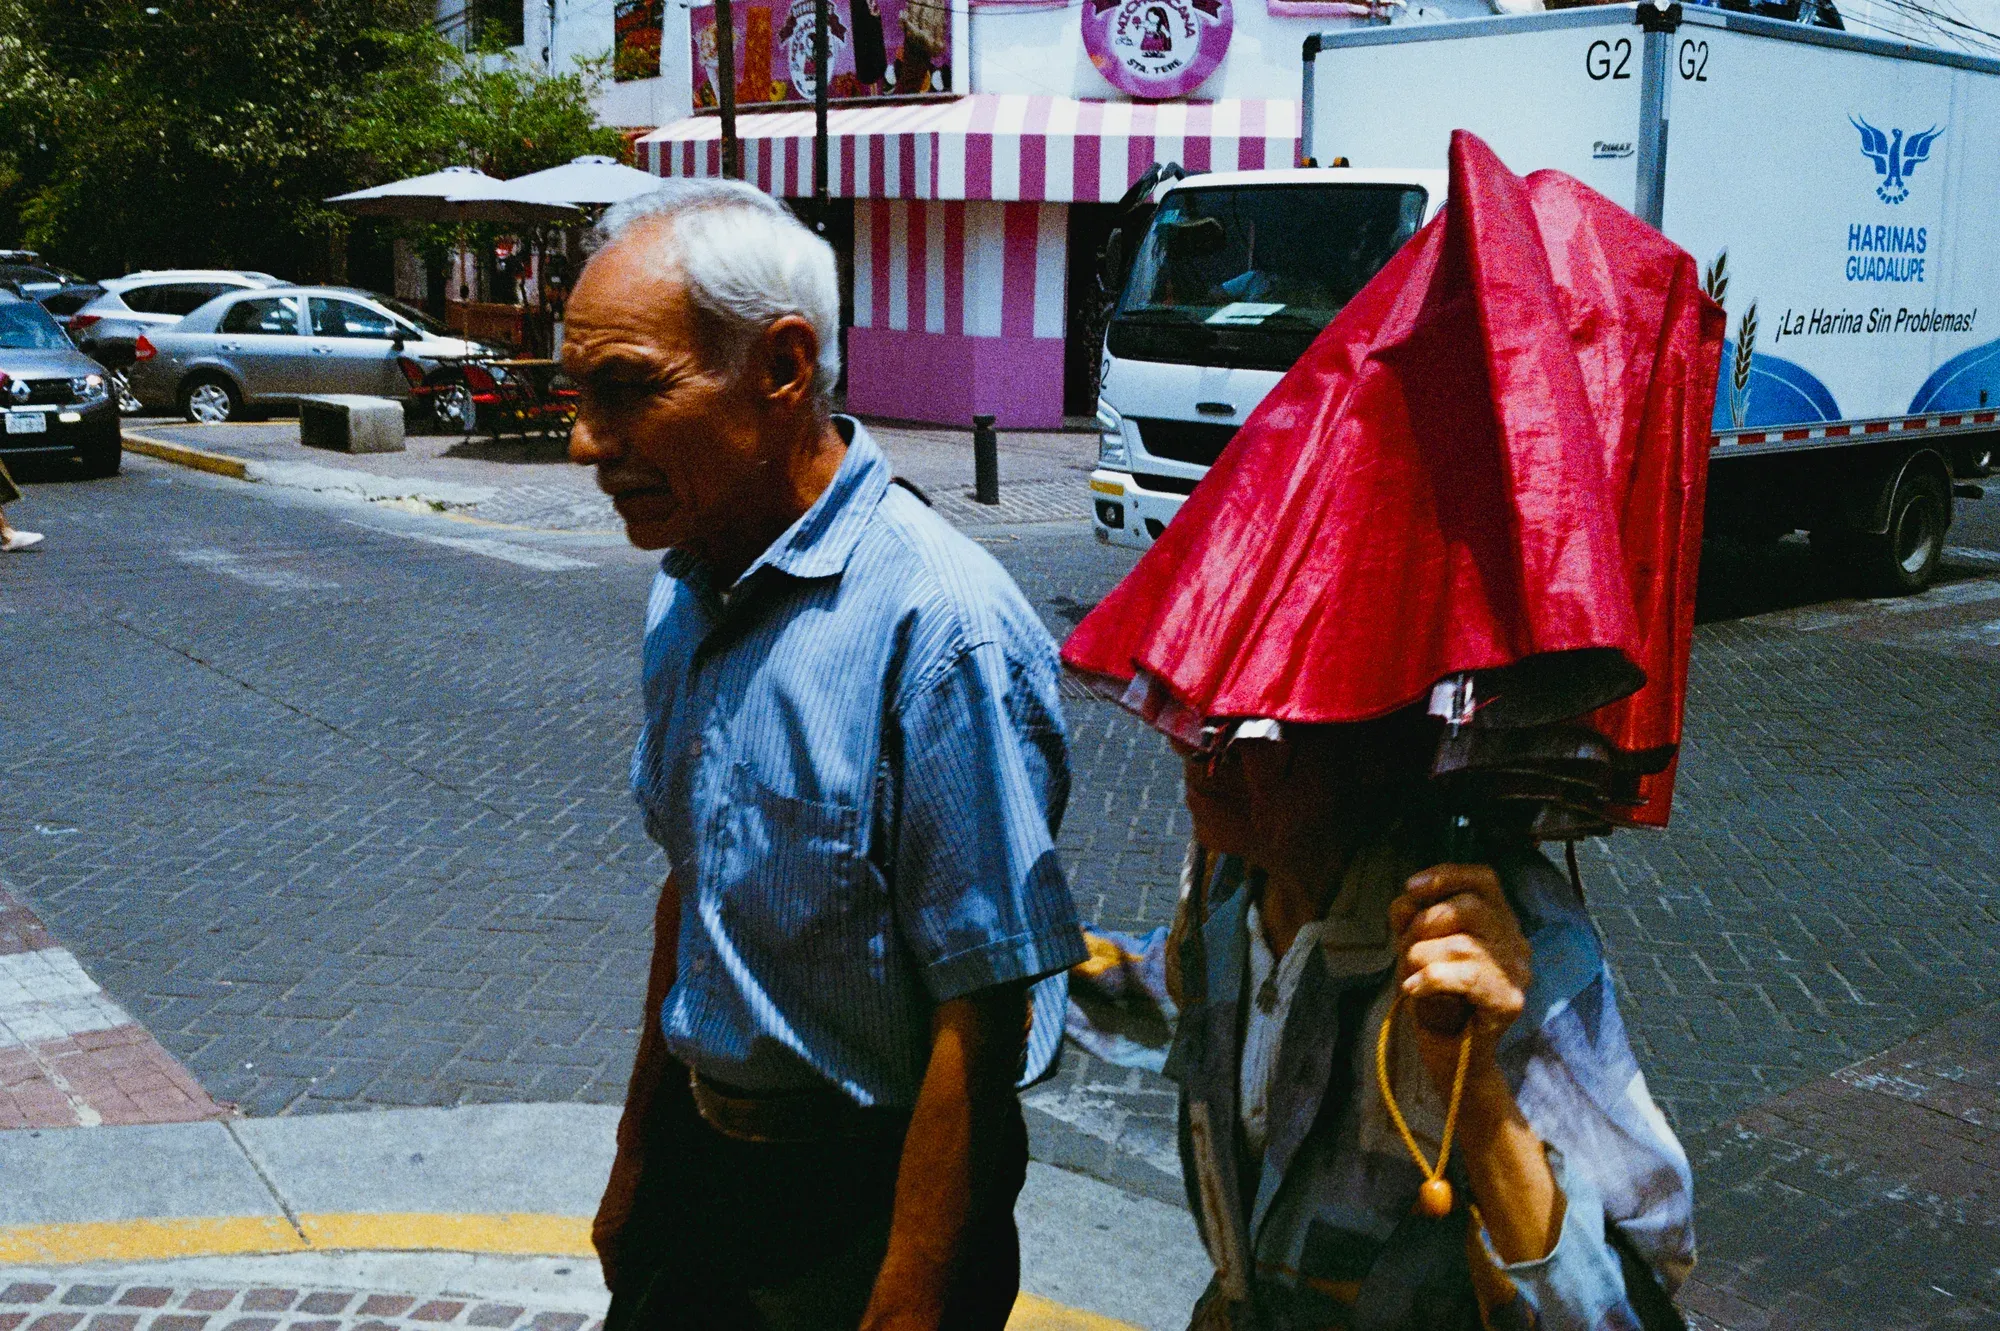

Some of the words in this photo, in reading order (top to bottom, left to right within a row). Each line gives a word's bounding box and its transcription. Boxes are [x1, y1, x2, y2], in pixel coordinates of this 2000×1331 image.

[1126, 58, 1149, 74] STA.
[1153, 59, 1183, 74] TERE
[1586, 38, 1632, 81] G2
[1679, 39, 1709, 82] G2
[1848, 223, 1927, 253] HARINAS
[1845, 256, 1925, 282] GUADALUPE
[1775, 308, 1805, 343] ¡La
[1807, 308, 1864, 335] Harina
[1866, 307, 1892, 334] Sin
[1894, 308, 1978, 333] Problemas!
